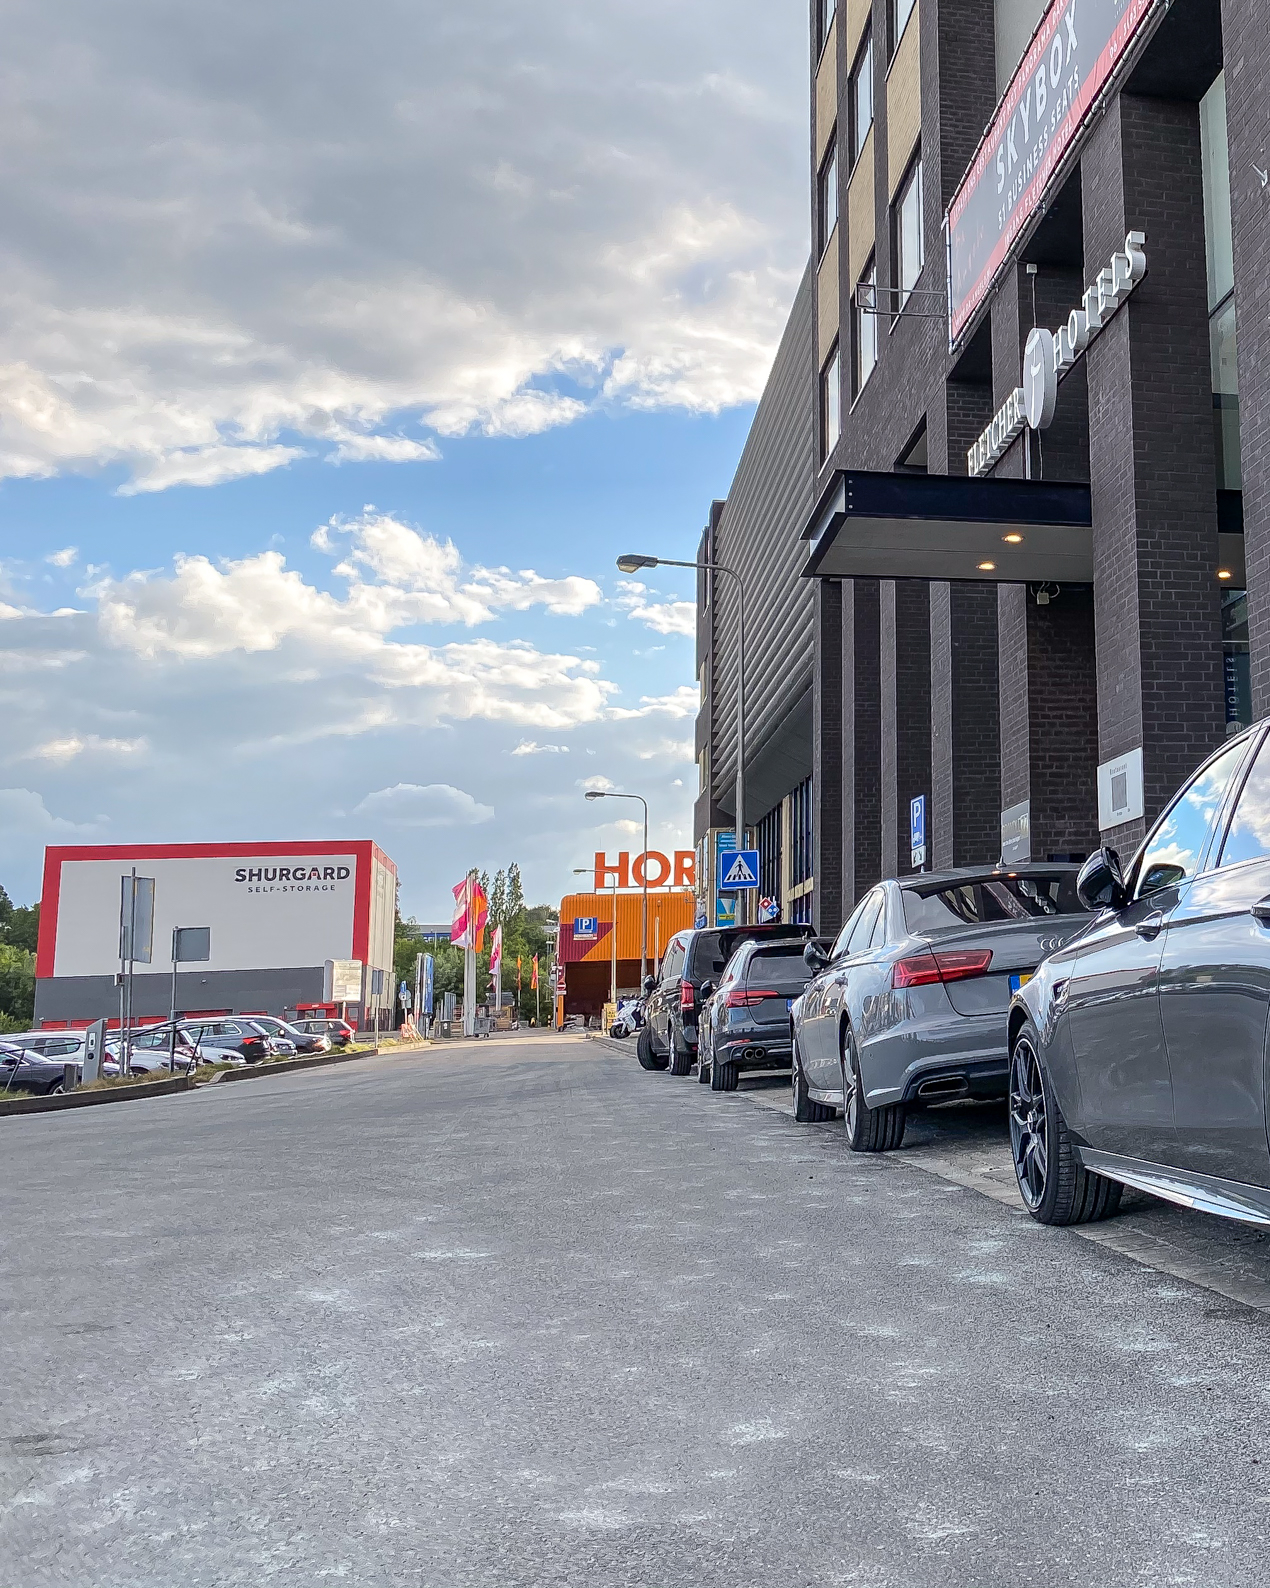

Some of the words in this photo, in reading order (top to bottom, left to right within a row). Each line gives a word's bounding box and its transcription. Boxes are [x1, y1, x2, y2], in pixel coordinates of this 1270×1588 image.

[1018, 23, 1051, 92] PANORAMA
[995, 0, 1078, 194] SKYBOX
[1007, 125, 1048, 212] BUSINESS
[1051, 65, 1079, 132] SEATS
[1024, 156, 1051, 209] FLETCHER
[1053, 119, 1074, 157] HOTEL
[967, 387, 1023, 478] FLETCHER
[1052, 231, 1146, 373] HOTELS
[913, 801, 921, 828] P
[234, 866, 351, 882] SHURGARD
[247, 884, 336, 893] SELF-STORAGE
[594, 850, 696, 888] HOR
